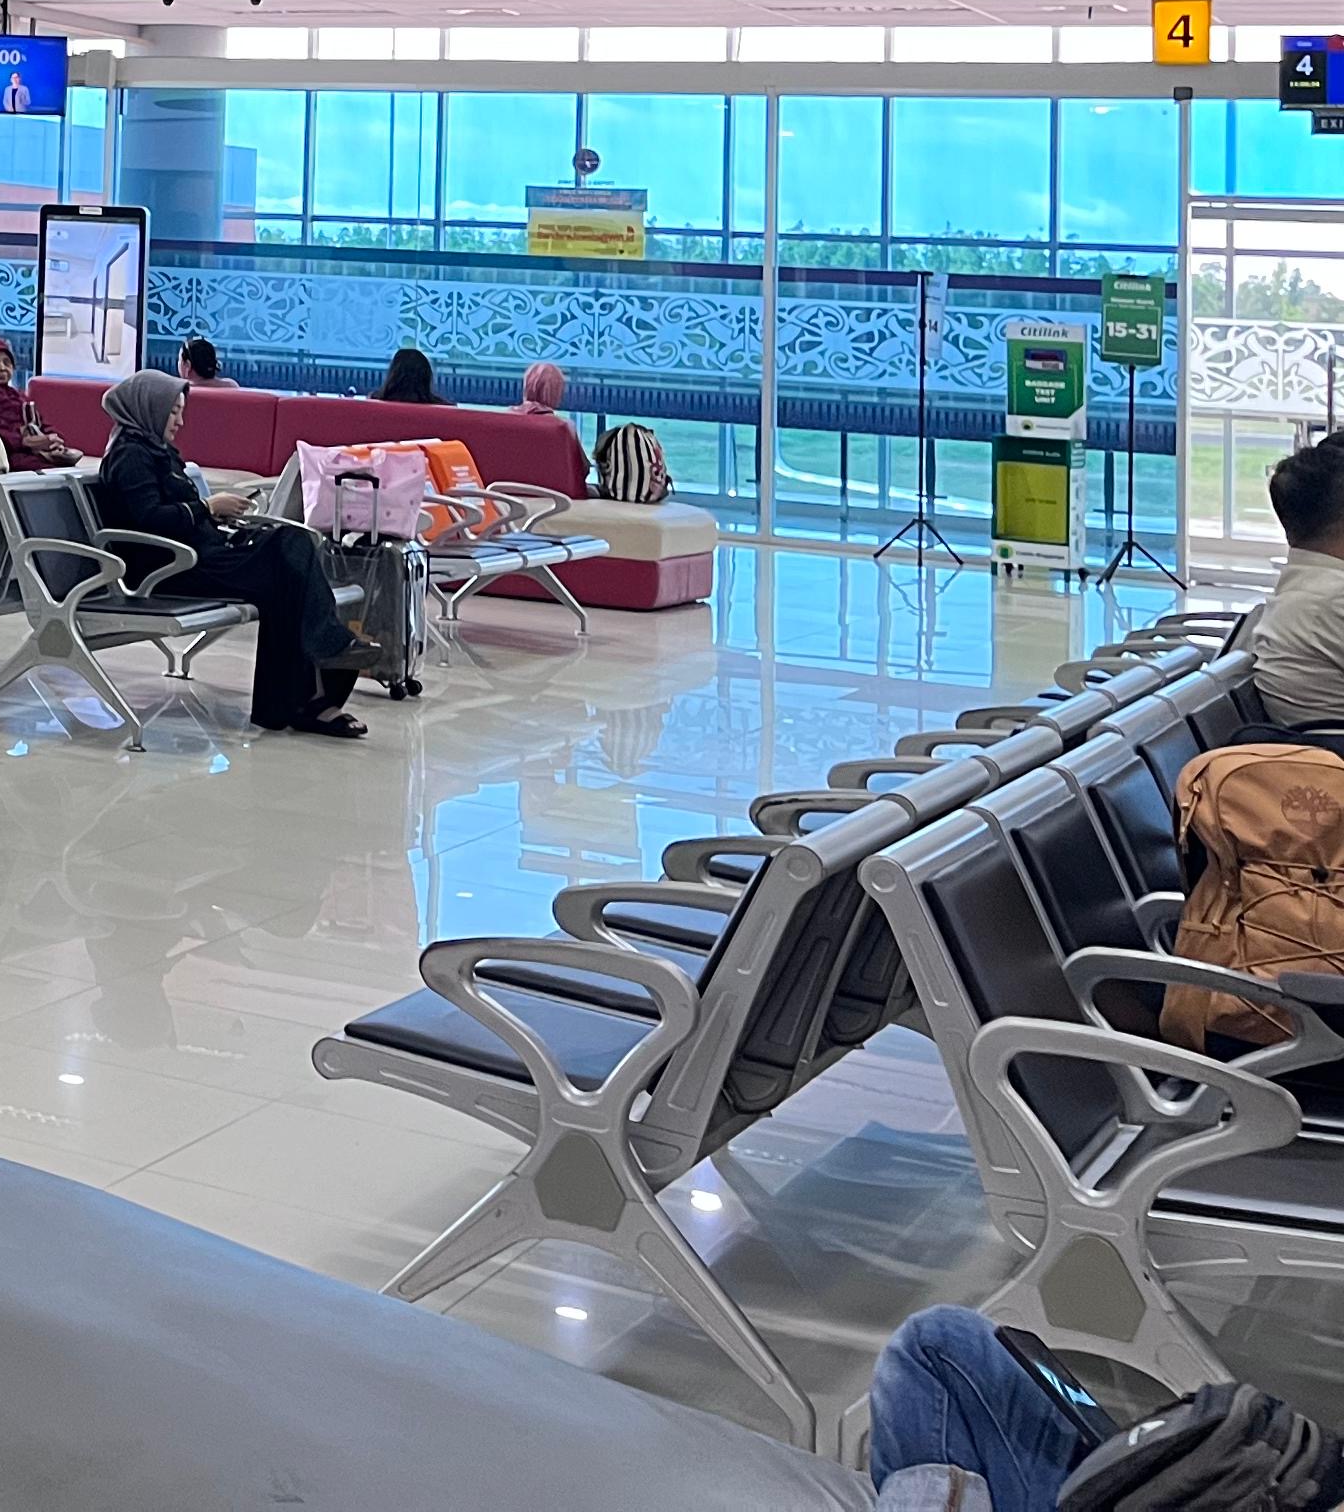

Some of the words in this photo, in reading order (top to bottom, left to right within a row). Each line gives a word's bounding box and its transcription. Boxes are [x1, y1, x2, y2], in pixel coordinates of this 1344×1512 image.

[1166, 15, 1194, 48] 4
[1296, 54, 1314, 76] 4
[1113, 280, 1152, 292] Citilink
[1020, 326, 1070, 339] Citilink
[1106, 321, 1158, 341] 15-31
